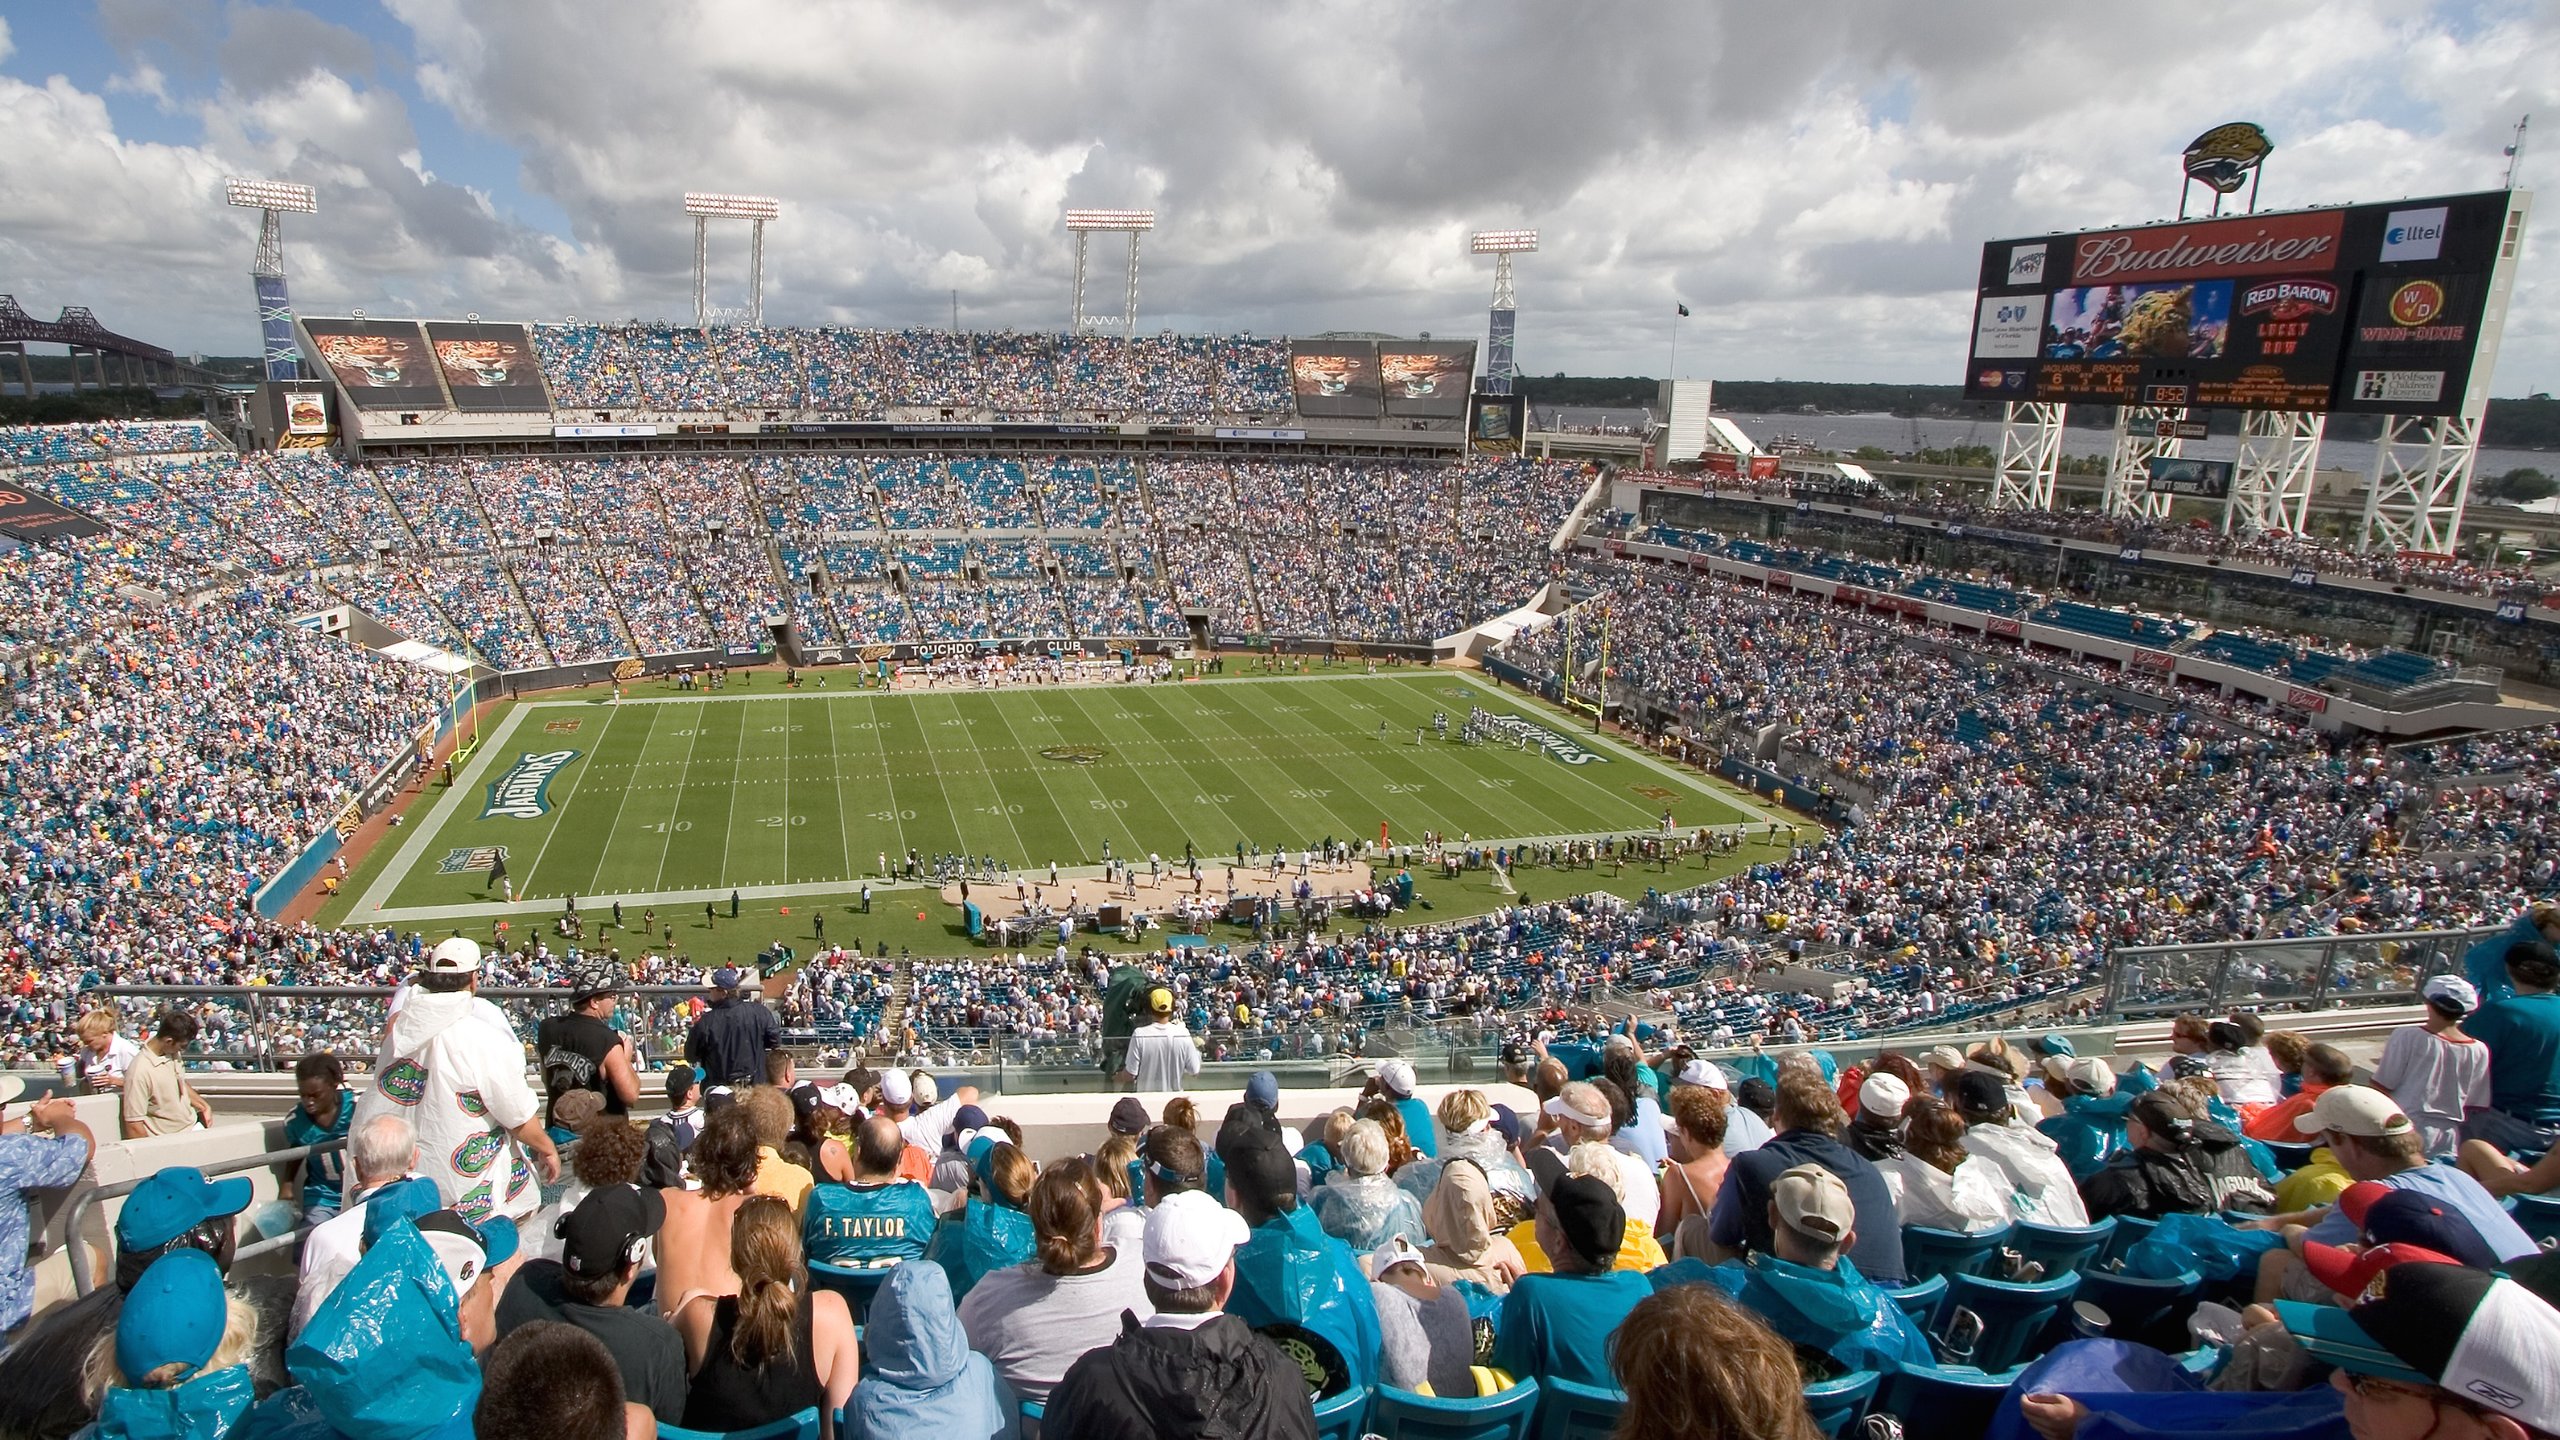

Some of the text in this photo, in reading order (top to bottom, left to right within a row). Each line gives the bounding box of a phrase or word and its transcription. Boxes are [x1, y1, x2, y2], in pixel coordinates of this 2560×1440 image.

[2076, 230, 2332, 279] Budweiser
[2247, 284, 2331, 305] RED BARON
[2258, 323, 2309, 337] LUCKY
[2262, 341, 2297, 355] ROW
[2041, 365, 2082, 374] JAGUARS
[2092, 365, 2140, 374] BRONCOS
[2052, 373, 2063, 384] 6
[2106, 373, 2124, 385] 14
[2391, 372, 2437, 381] Wolfson
[2389, 381, 2434, 390] Children's
[2155, 387, 2186, 401] 8:52
[2387, 389, 2432, 397] HOSPITAL
[1947, 525, 1963, 535] ADT
[2120, 549, 2141, 561] ADT
[2291, 573, 2316, 585] ADT
[2496, 605, 2524, 620] ADT
[1988, 619, 2018, 634] Bud
[1047, 641, 1081, 651] CLUB
[2135, 652, 2169, 667] Bud
[2289, 690, 2321, 708] Bud
[771, 724, 804, 734] 20
[485, 750, 575, 819] JAGUARS
[1382, 782, 1421, 794] 20
[1193, 793, 1231, 805] 40
[1288, 787, 1328, 799] 30
[986, 804, 1025, 816] 40
[1089, 799, 1129, 810] 50
[766, 815, 807, 828] 20
[878, 810, 917, 822] 30
[653, 820, 693, 833] 10
[544, 1045, 597, 1086] JAGUARS
[825, 1217, 905, 1237] F. TAYLOR
